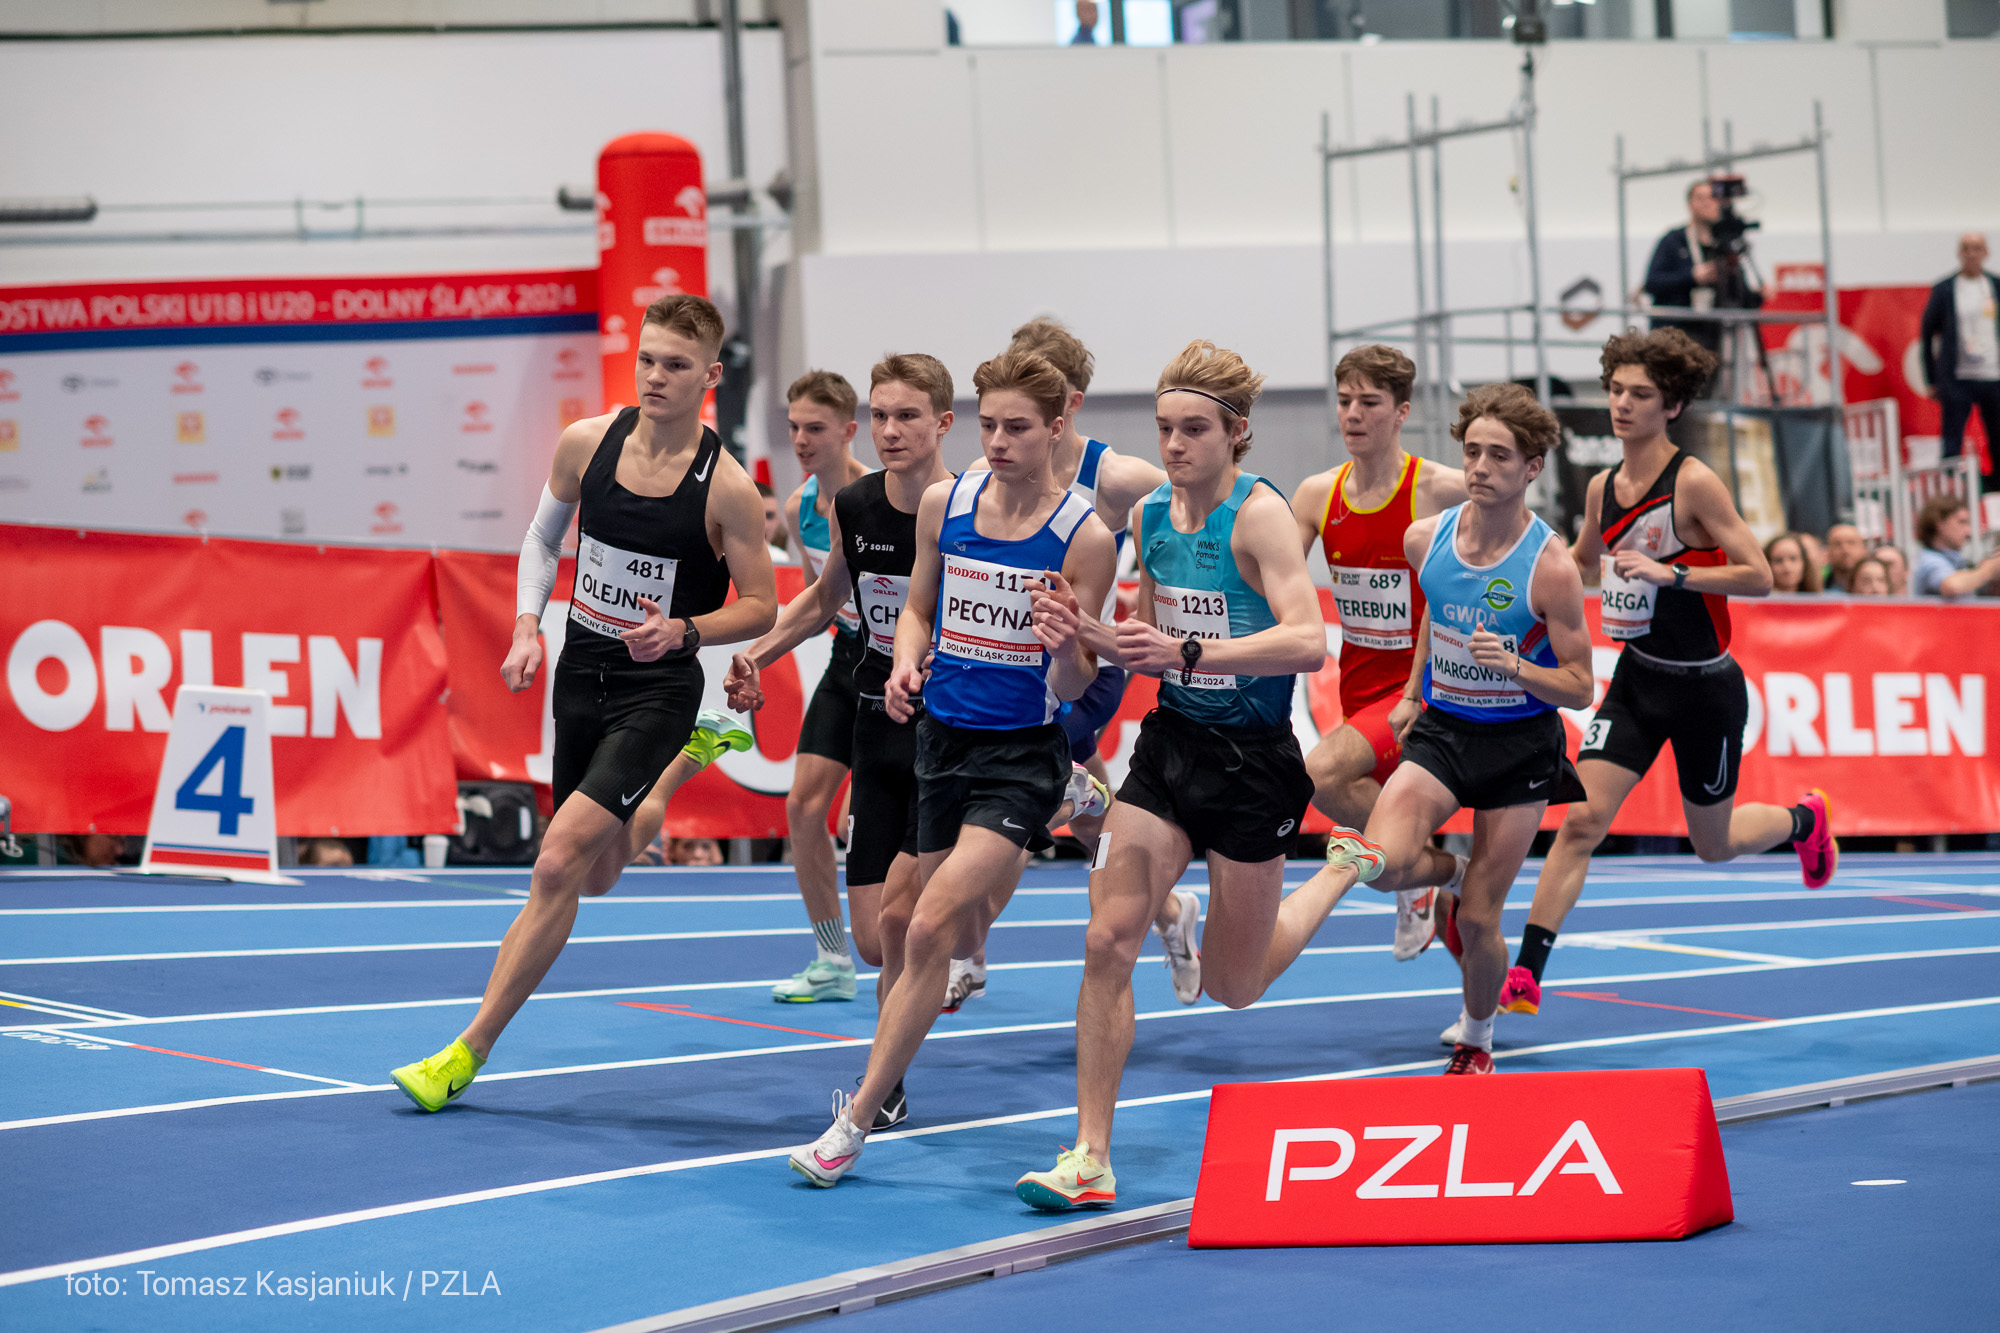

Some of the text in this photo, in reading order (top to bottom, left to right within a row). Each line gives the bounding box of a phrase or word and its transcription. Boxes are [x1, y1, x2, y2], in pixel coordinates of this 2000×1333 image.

[91, 295, 187, 325] POLSKI
[188, 293, 243, 323] U18
[259, 290, 315, 321] U20
[332, 288, 427, 319] DOLNY
[514, 282, 577, 314] 2024
[625, 558, 666, 581] 481
[947, 564, 990, 582] BODZIO
[1369, 573, 1402, 589] 689
[872, 588, 899, 597] ORLEN
[948, 596, 1034, 631] PECYNA
[1181, 594, 1225, 617] 1213
[1335, 597, 1406, 620] TEREBUN
[1442, 603, 1500, 627] GWDA
[577, 612, 627, 638] DOLNY ŚLĄS
[967, 636, 999, 648] Mistrzostwa
[1432, 630, 1464, 649] BODZIO
[946, 641, 1031, 663] DOLNY ŚLĄSK 2024
[1202, 677, 1225, 686] 2024
[1584, 722, 1602, 747] 3
[175, 725, 255, 836] 4
[1265, 1120, 1624, 1202] PZLA
